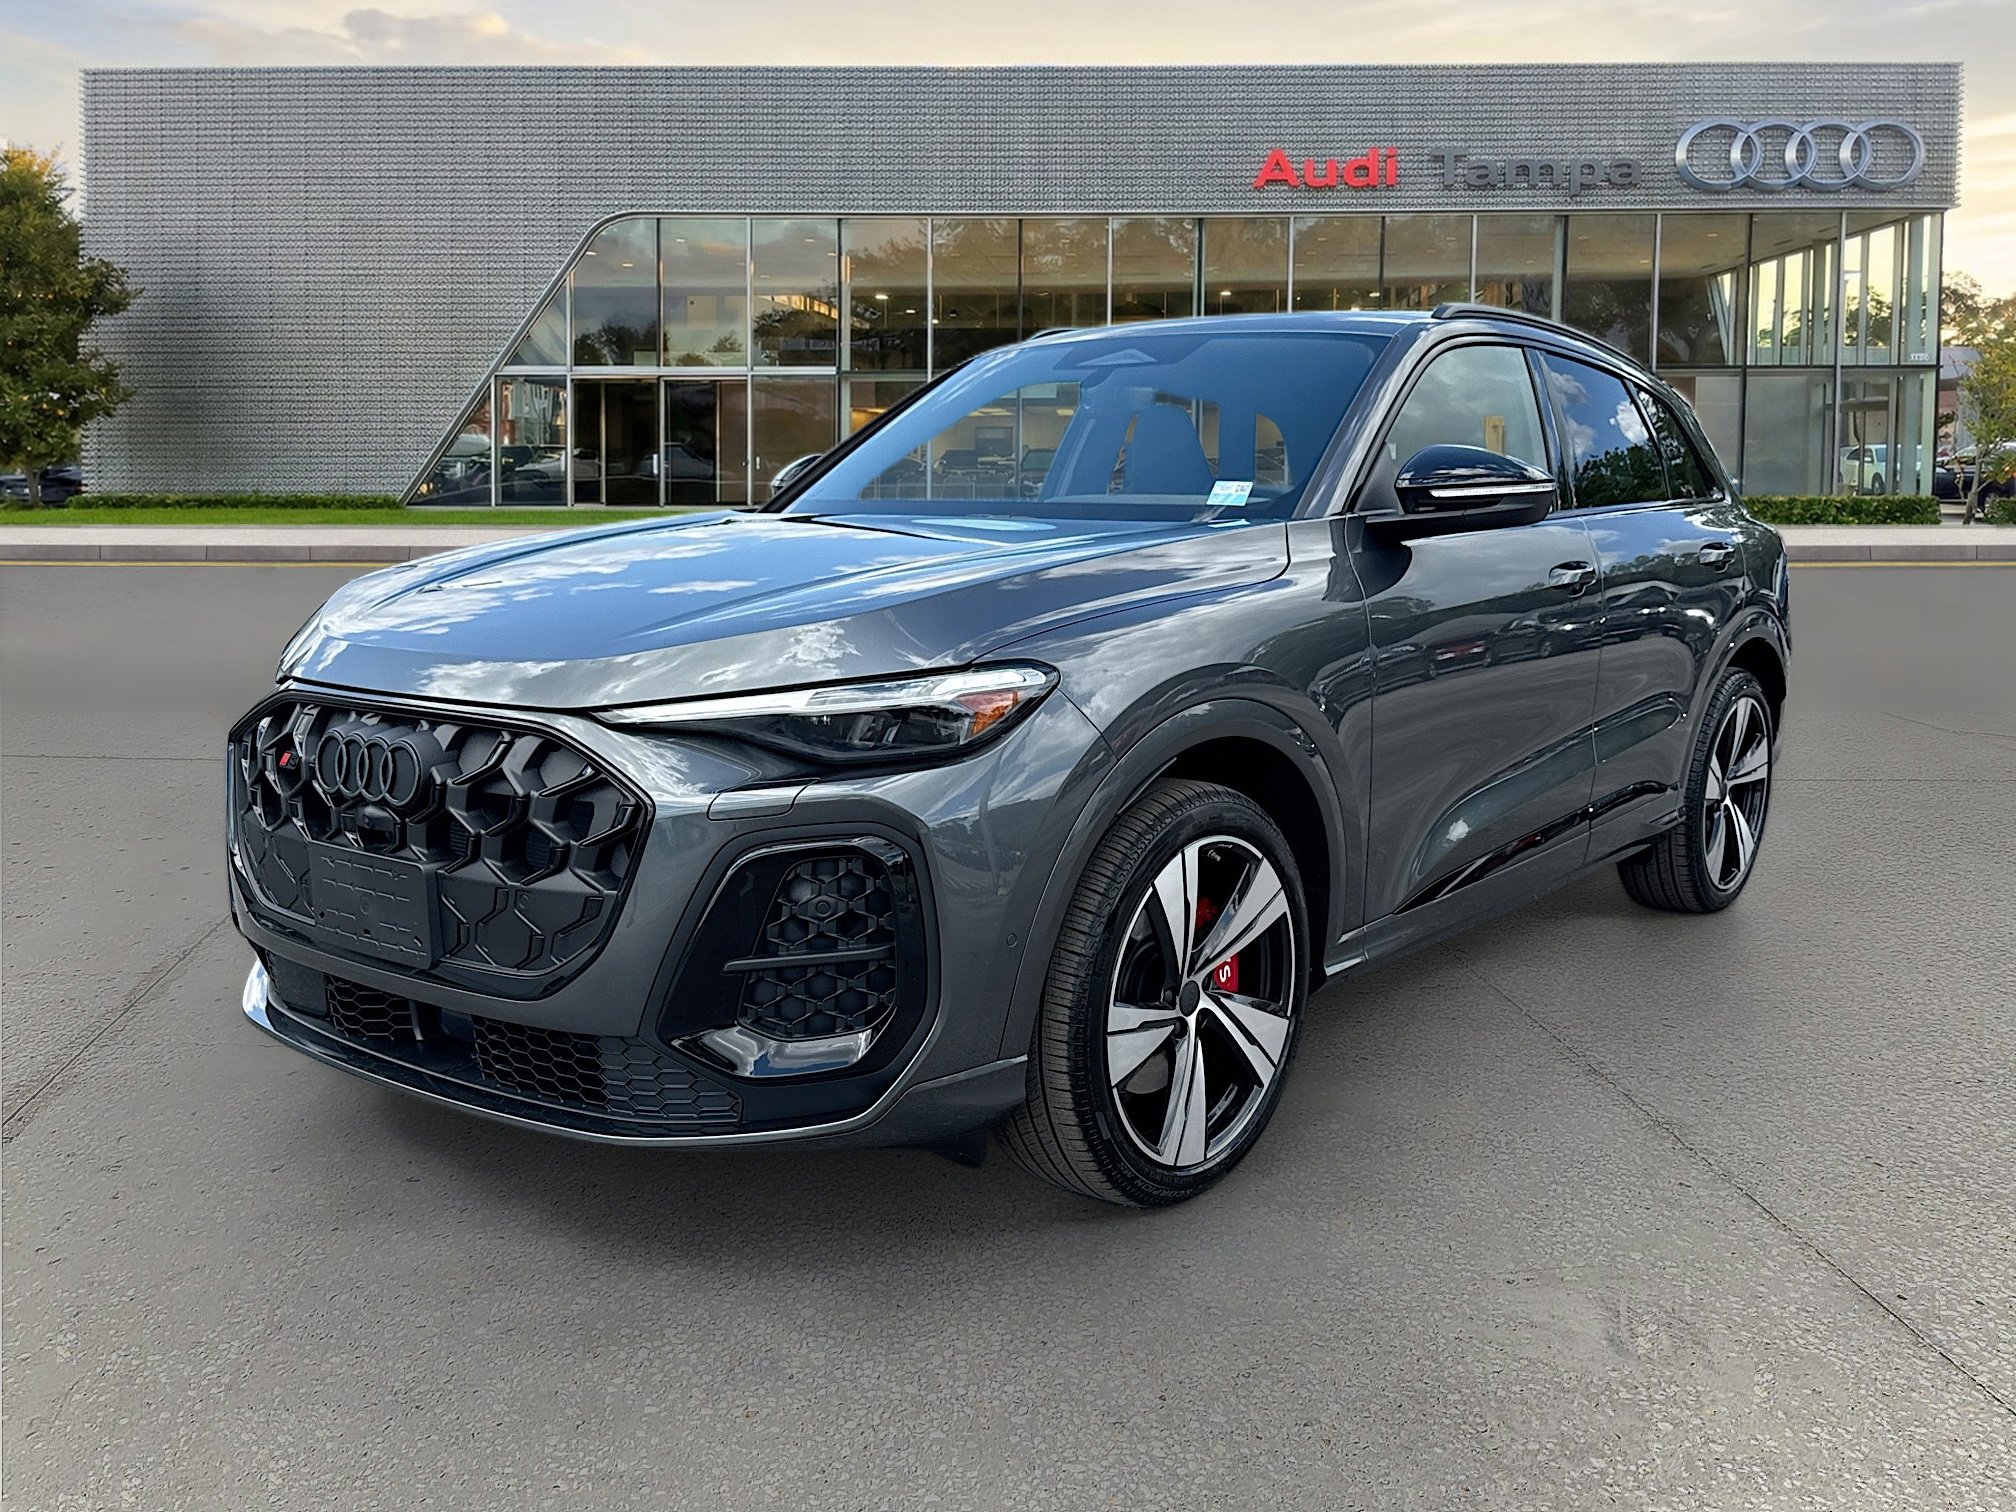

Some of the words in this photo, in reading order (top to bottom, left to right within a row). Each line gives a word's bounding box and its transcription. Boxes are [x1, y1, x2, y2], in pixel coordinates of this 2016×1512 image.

[1253, 146, 1398, 188] Audi
[1430, 148, 1643, 199] Tampa
[1219, 964, 1231, 982] S
[1134, 1179, 1193, 1198] SCORPION
